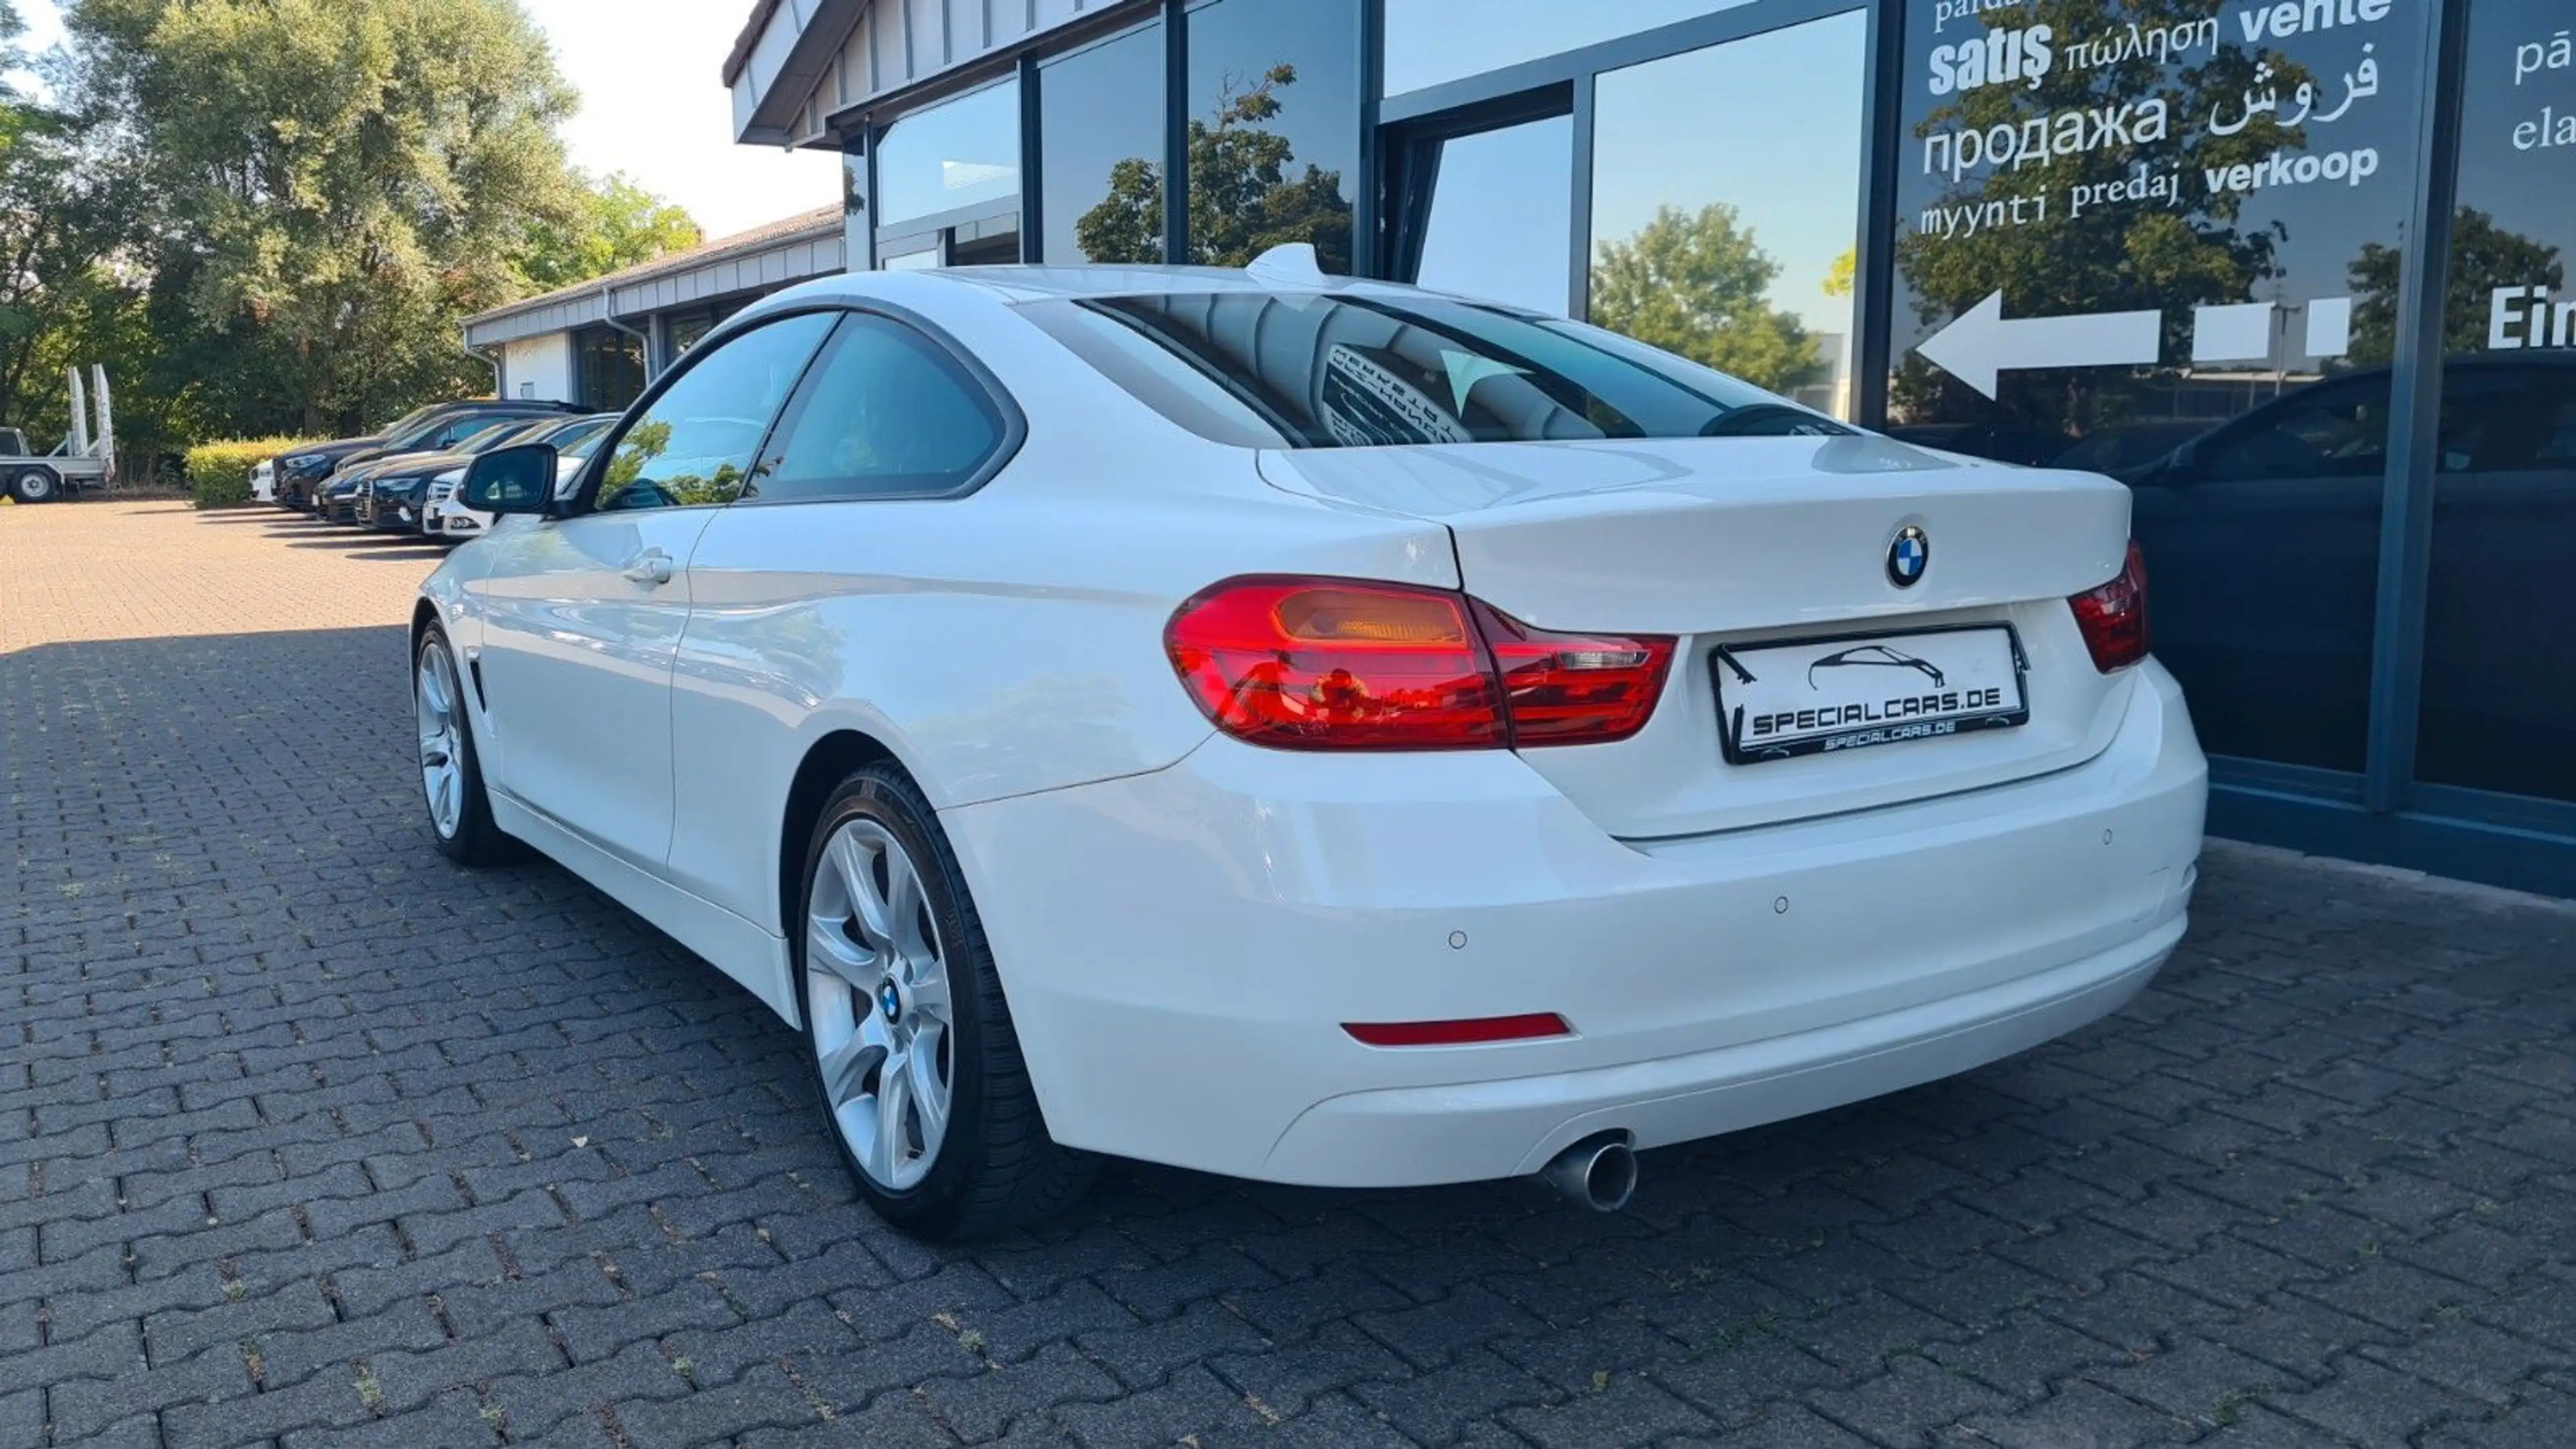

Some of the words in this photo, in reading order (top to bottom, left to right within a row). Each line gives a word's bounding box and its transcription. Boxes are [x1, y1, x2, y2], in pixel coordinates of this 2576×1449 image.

[2065, 17, 2219, 71] πώληση
[2239, 0, 2392, 42] vente
[1929, 23, 2053, 95] satış
[1923, 98, 2167, 183] продажа
[1921, 185, 2046, 240] myynti
[2070, 162, 2180, 219] predaj
[2205, 147, 2379, 194] verkoop
[1753, 688, 2000, 735] SPECIALCARS.DE
[1824, 721, 1956, 751] SPECIALCARS.DE
